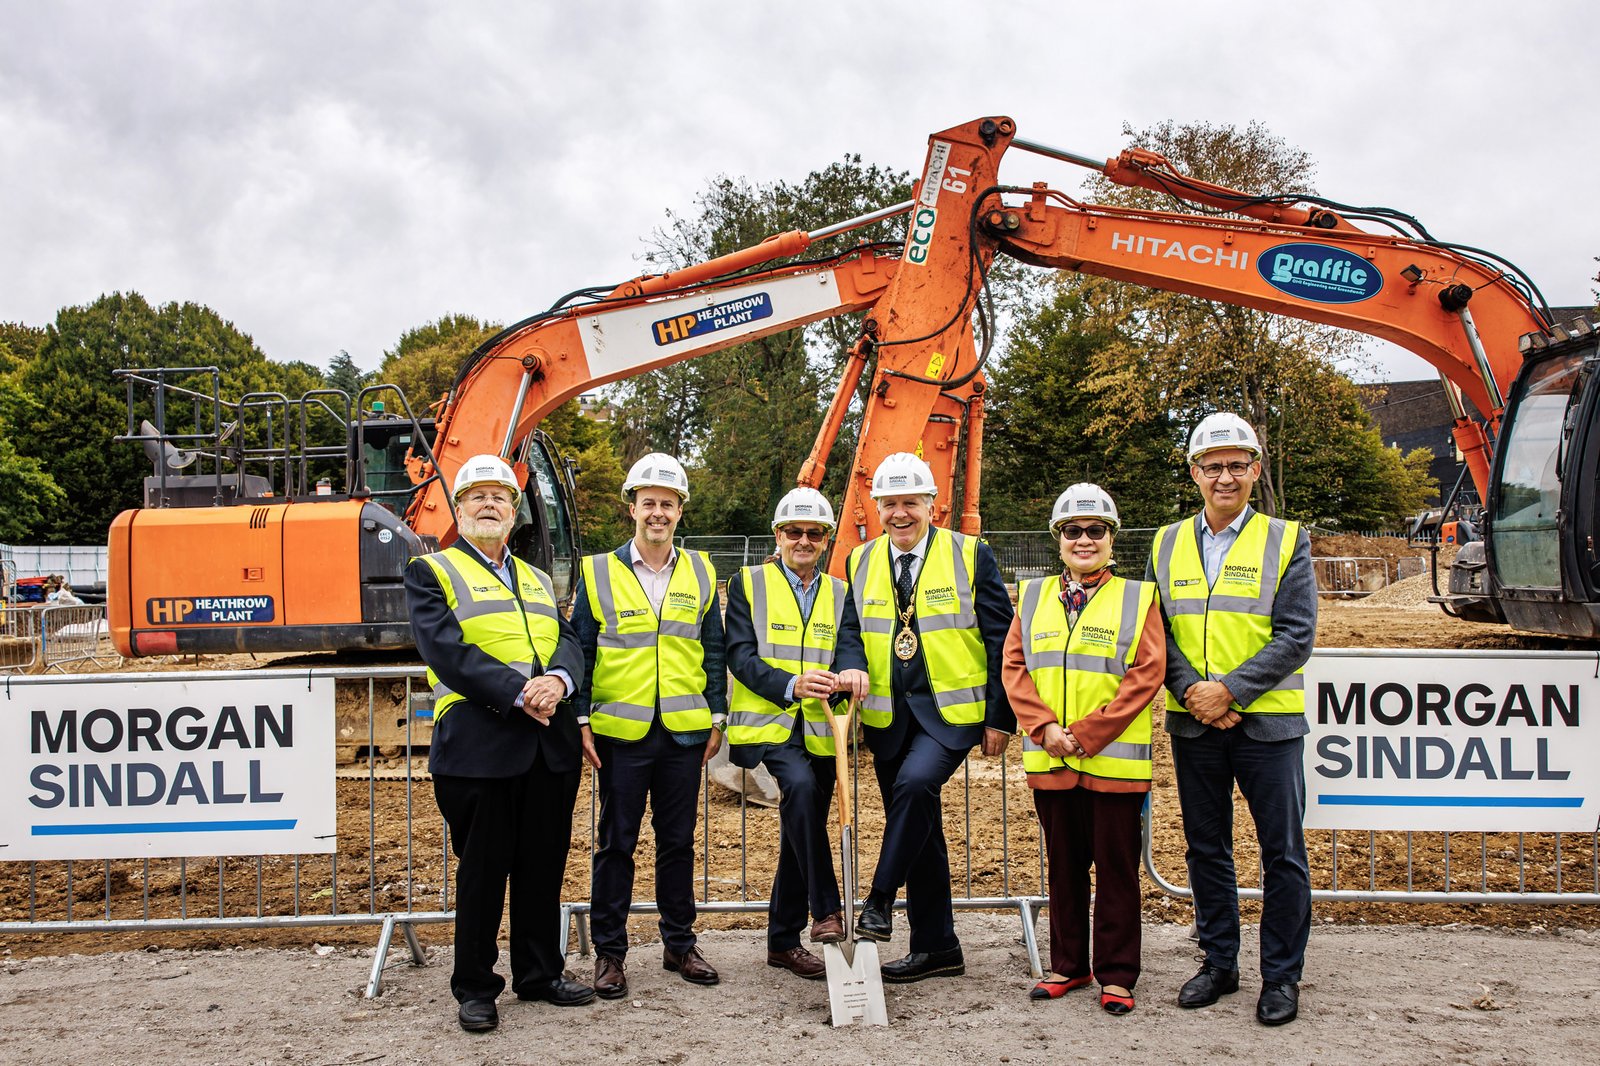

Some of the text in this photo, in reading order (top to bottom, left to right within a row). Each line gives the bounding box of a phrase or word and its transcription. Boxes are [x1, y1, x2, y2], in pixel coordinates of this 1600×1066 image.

[923, 144, 947, 202] HITACHI
[942, 166, 971, 194] 61
[1111, 232, 1249, 270] HITACHI
[1303, 280, 1327, 290] Engineering
[657, 295, 764, 343] HP HEATHROW
[714, 310, 753, 329] PLANT
[1224, 564, 1258, 574] MORGAN
[1224, 571, 1255, 579] SINDALL
[669, 592, 697, 601] MORGAN
[925, 586, 955, 595] MORGAN
[926, 592, 955, 601] SINDALL
[669, 597, 695, 606] SINDALL
[152, 598, 268, 623] HP HEATHROW
[211, 611, 253, 621] PLANT
[1081, 625, 1115, 636] MORGAN
[1081, 632, 1112, 642] SINDALL
[1317, 682, 1580, 727] MORGAN
[31, 704, 293, 754] MORGAN
[1314, 735, 1571, 781] SINDALL
[28, 759, 284, 809] SINDALL
